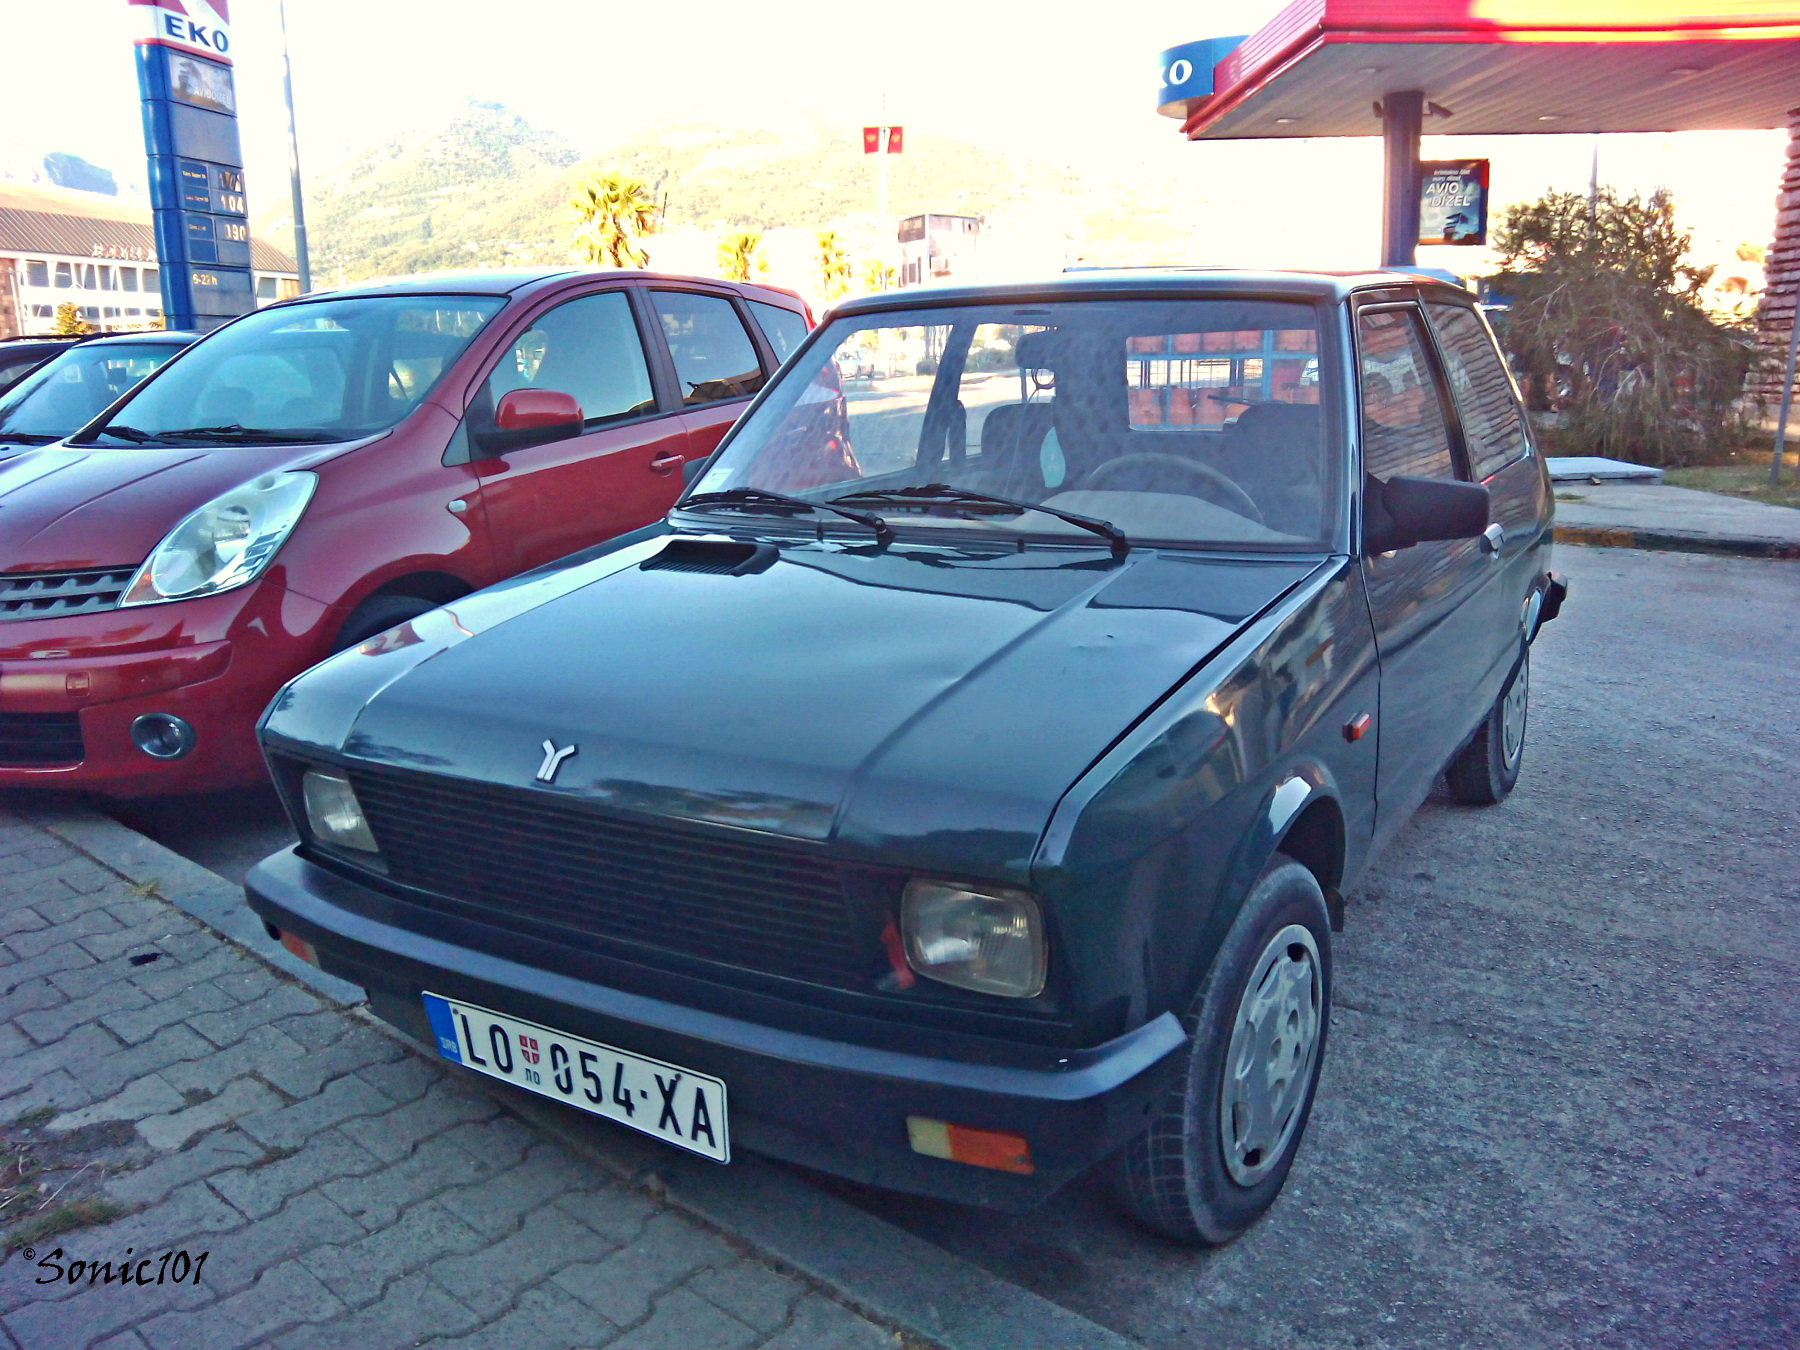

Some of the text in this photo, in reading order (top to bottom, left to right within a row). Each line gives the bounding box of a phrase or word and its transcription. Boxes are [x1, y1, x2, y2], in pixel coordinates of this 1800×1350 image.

[164, 13, 229, 52] EKO
[1426, 182, 1460, 195] AVIO
[220, 195, 244, 213] 104
[1431, 195, 1471, 207] DIZEL
[439, 1036, 458, 1054] SRB
